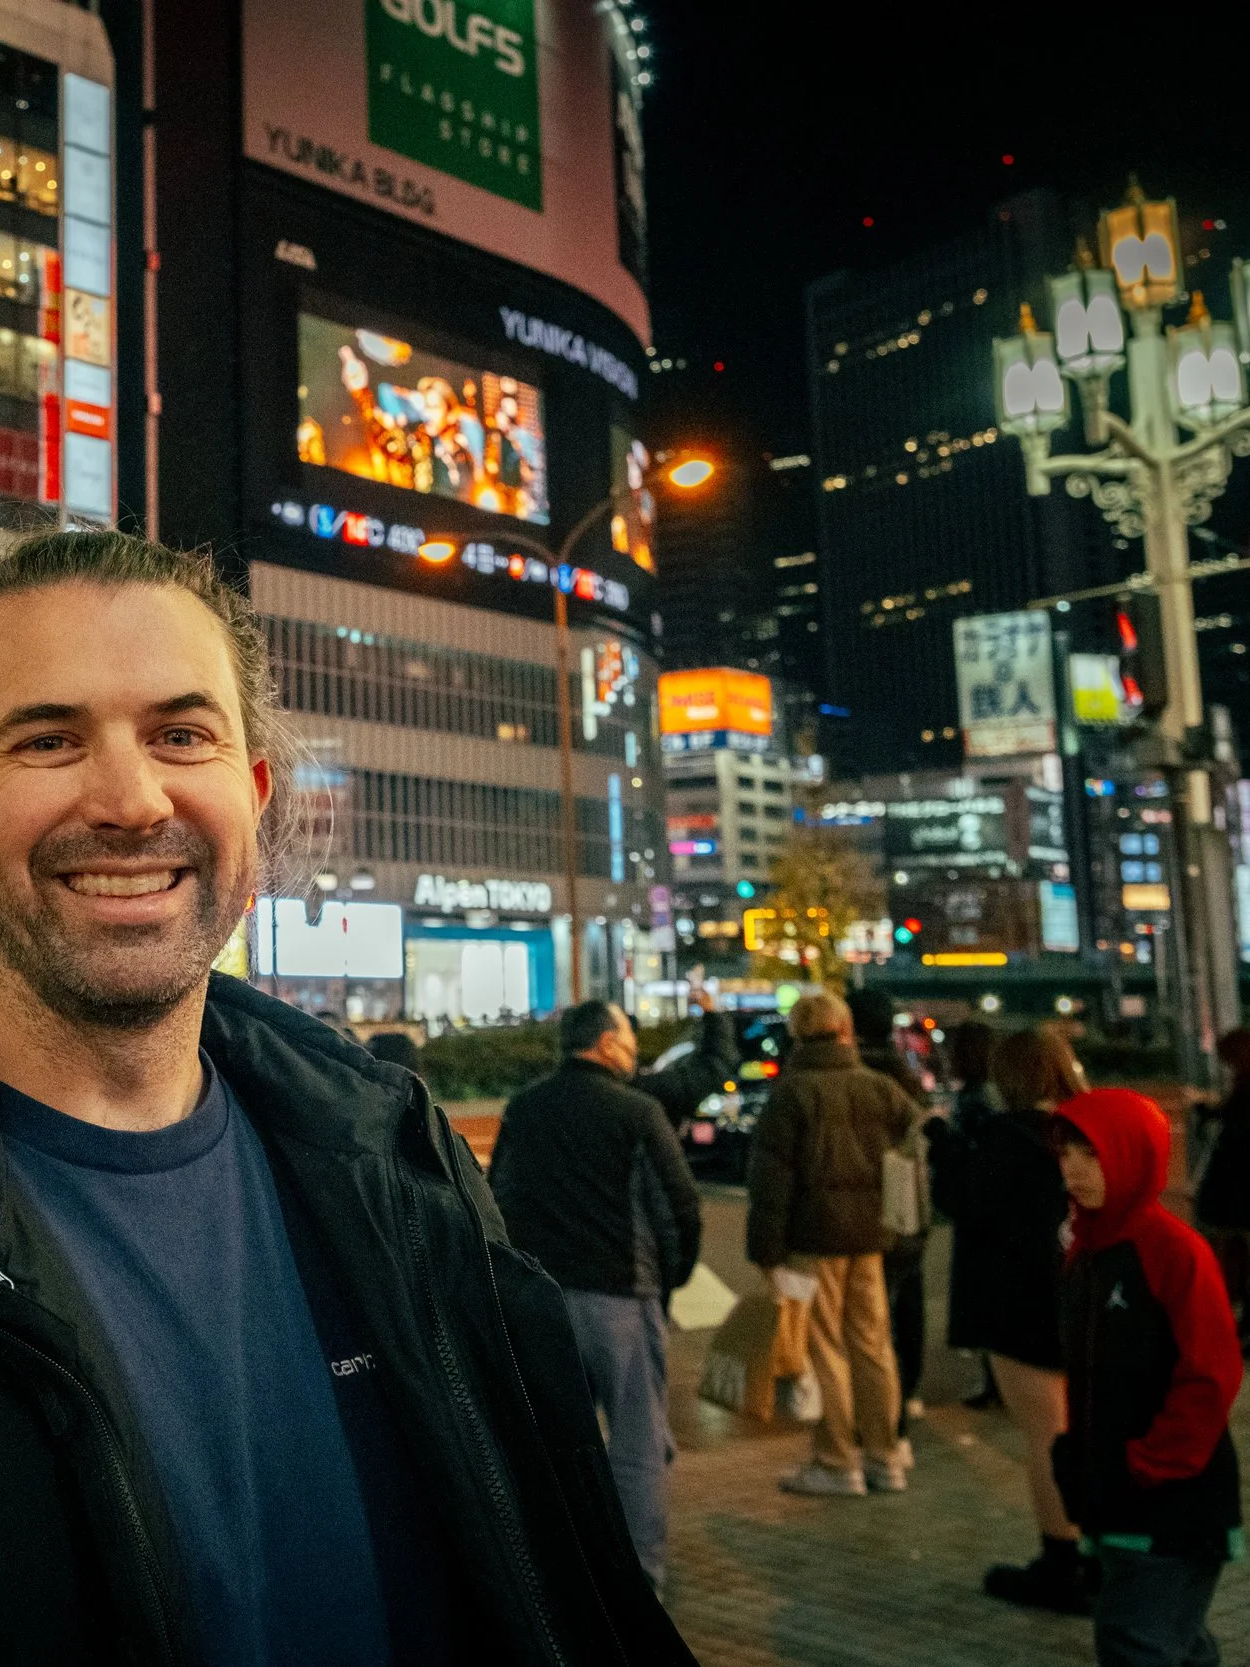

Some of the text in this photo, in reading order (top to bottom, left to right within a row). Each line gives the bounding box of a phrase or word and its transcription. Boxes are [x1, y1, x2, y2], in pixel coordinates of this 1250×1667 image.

[379, 62, 530, 144] FLAGSHIP
[262, 119, 371, 190] YUNIKA
[438, 118, 531, 176] STORE
[498, 305, 589, 368] YUNIKA
[485, 879, 553, 913] TOKYO
